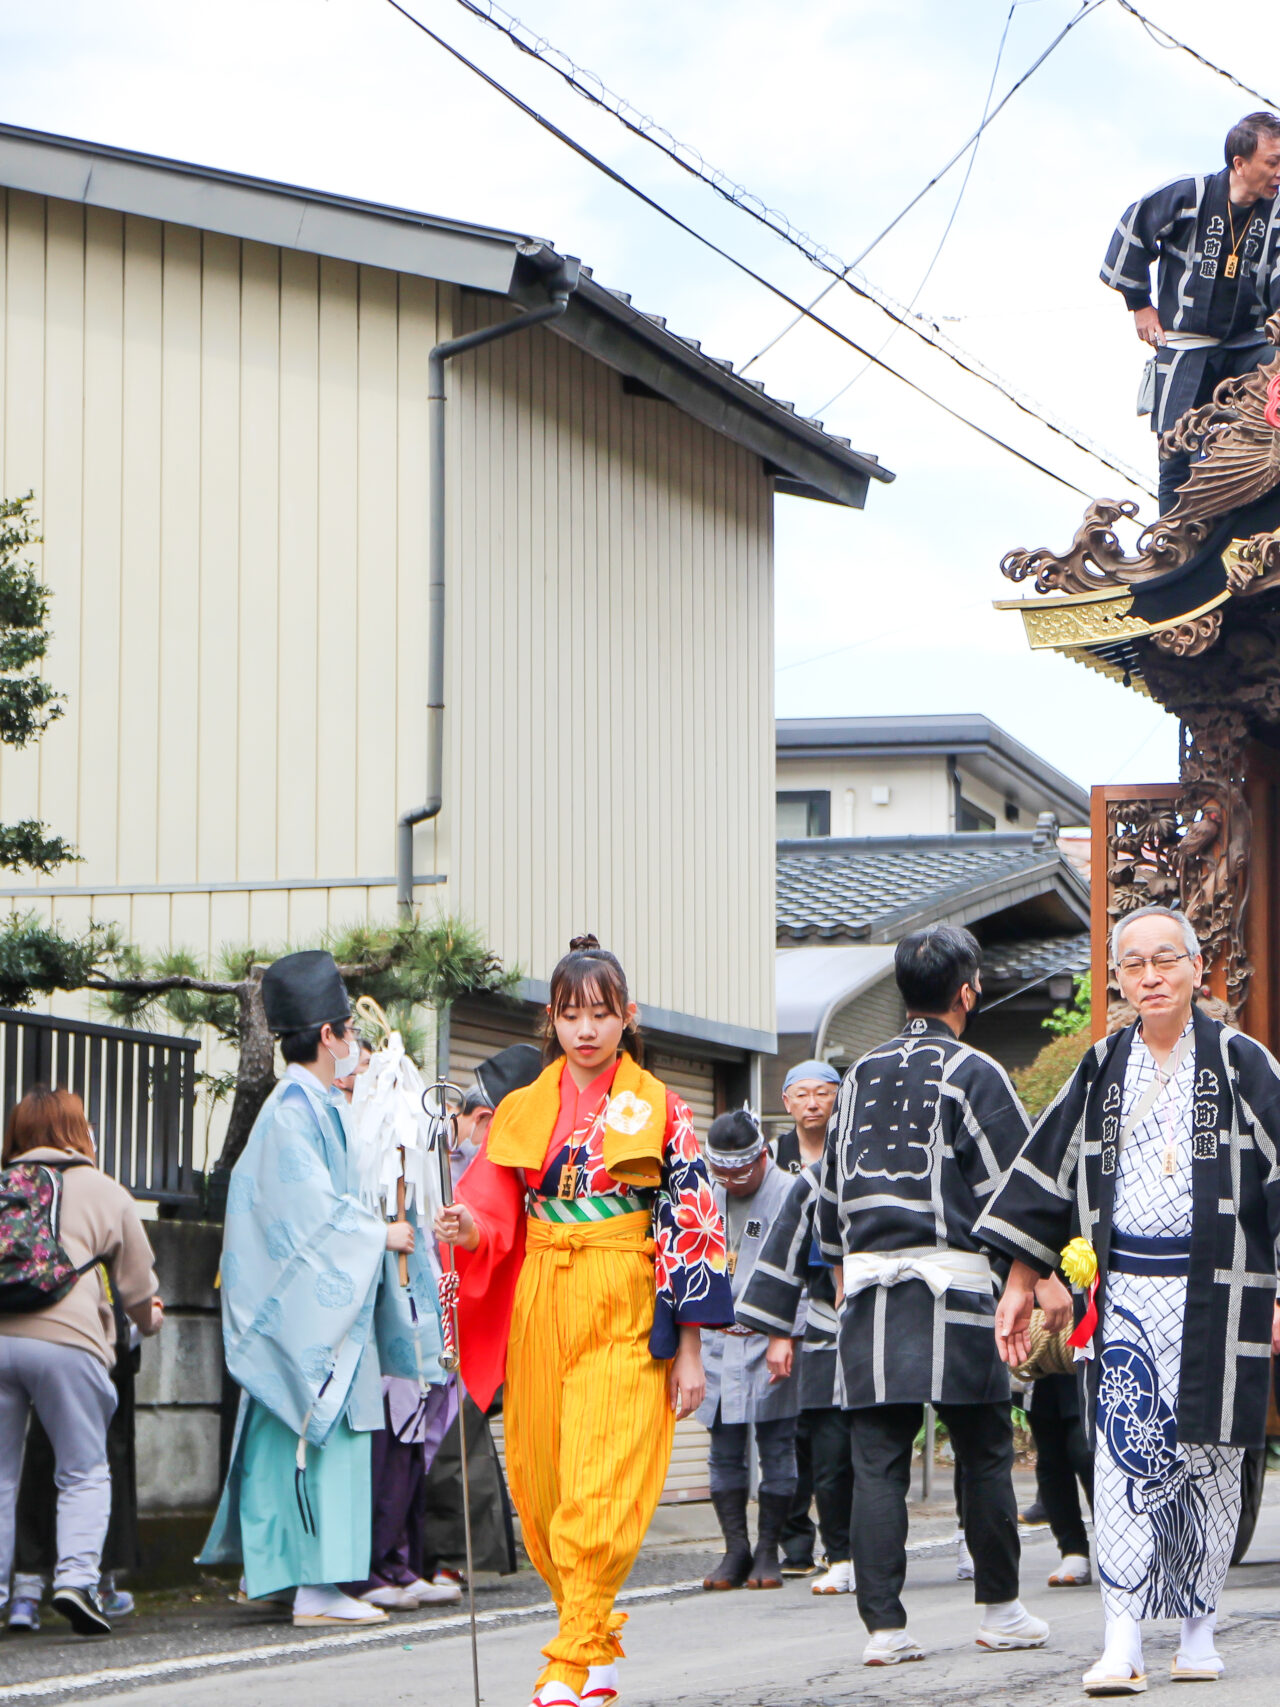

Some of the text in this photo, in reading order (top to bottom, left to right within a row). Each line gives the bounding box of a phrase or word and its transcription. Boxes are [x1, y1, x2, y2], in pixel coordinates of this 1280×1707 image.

[1102, 1083, 1120, 1175] 上町睦
[1193, 1068, 1220, 1160] 上町睦
